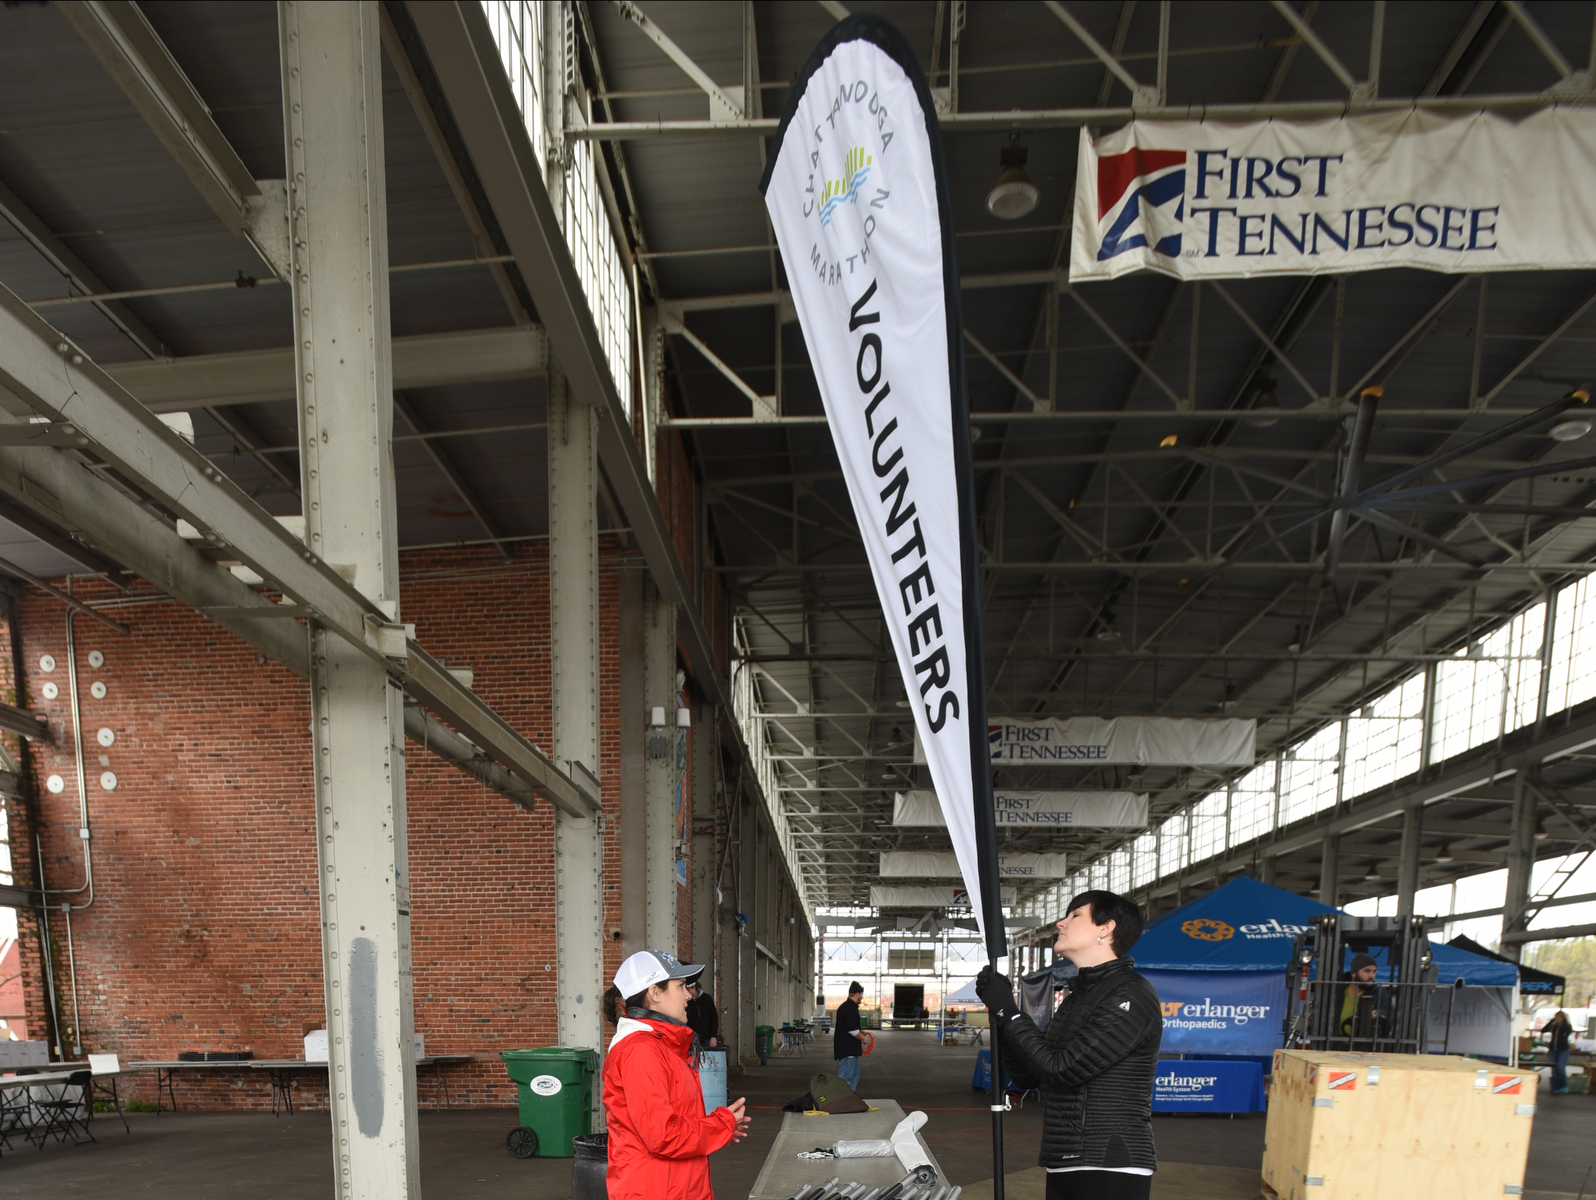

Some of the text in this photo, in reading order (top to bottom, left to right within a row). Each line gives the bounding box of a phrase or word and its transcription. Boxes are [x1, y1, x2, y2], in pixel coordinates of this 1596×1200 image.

[803, 80, 894, 218] CHATTANOOGA
[1193, 149, 1343, 199] FIRST
[810, 187, 890, 285] MARATHON
[1190, 204, 1500, 258] TENNESSEE
[849, 277, 960, 734] VOLUNTEERS
[1005, 725, 1054, 741] FIRST
[1004, 743, 1107, 759] TENNESSEE
[996, 796, 1033, 809] FIRST
[998, 810, 1072, 823] TENNESSEE
[1000, 866, 1035, 875] NESSEE
[1184, 998, 1270, 1025] erlanger
[1163, 1018, 1227, 1030] Orthopaedics
[1156, 1072, 1217, 1091] erlanger
